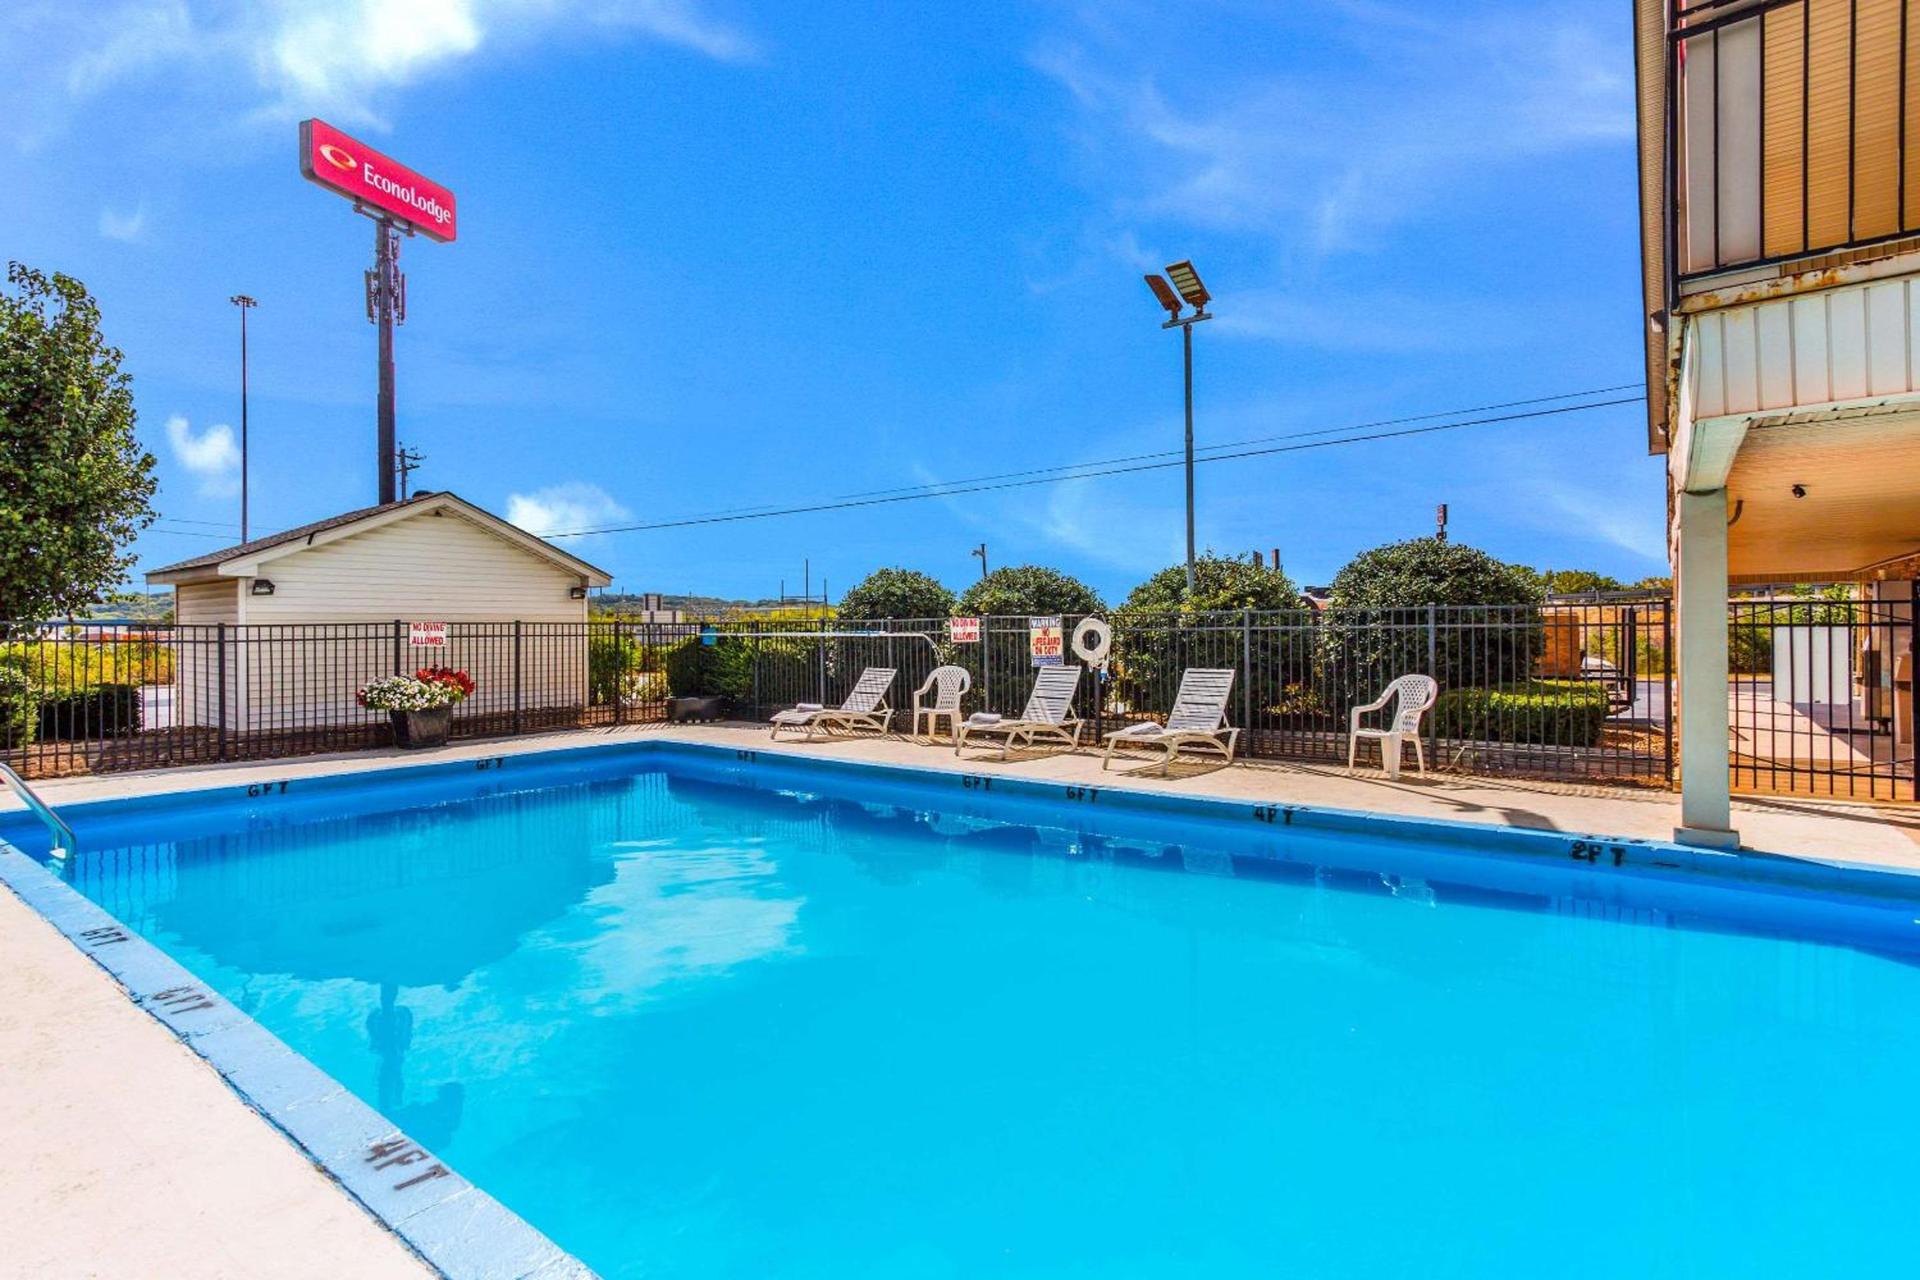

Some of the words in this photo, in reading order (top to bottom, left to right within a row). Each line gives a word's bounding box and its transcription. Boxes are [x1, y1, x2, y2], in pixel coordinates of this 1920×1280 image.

[364, 162, 451, 224] EconoLodge
[412, 622, 422, 632] NO
[423, 622, 446, 632] DIVING
[951, 618, 959, 627] NO
[953, 631, 978, 641] ALLOWED
[1041, 627, 1049, 637] NO
[411, 636, 444, 645] ALLOWED
[1032, 637, 1061, 646] LIFEGUARD
[1035, 645, 1043, 655] ON
[1044, 645, 1058, 655] DUTY
[364, 1138, 450, 1191] 4FT
